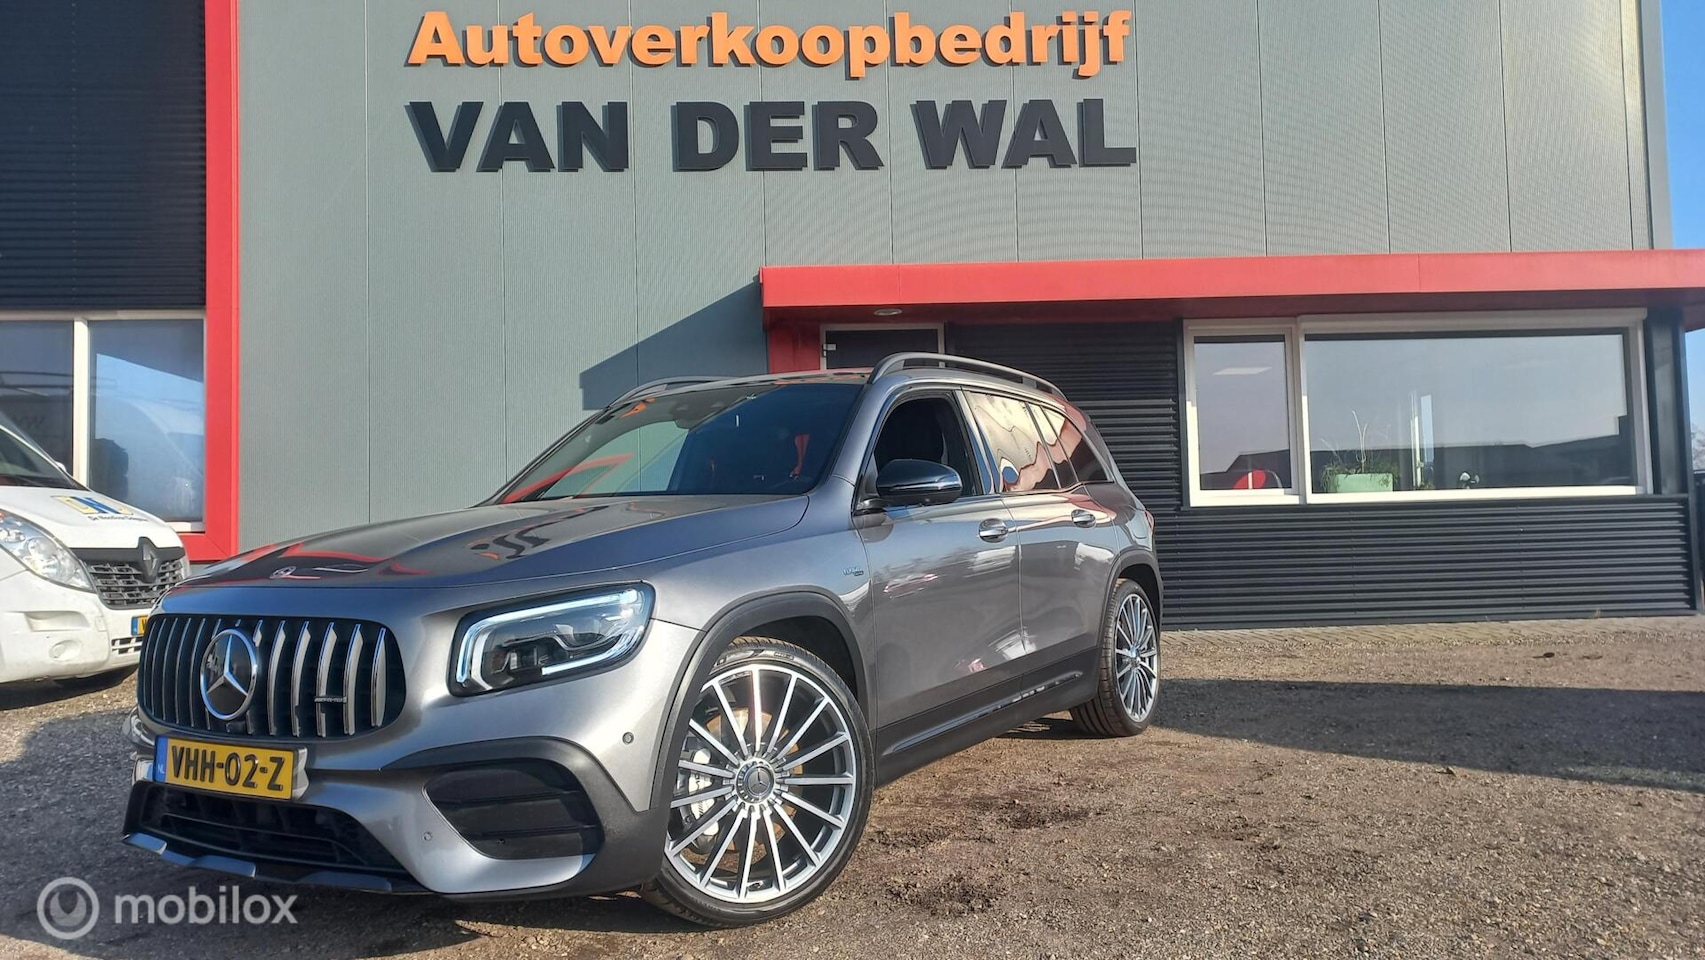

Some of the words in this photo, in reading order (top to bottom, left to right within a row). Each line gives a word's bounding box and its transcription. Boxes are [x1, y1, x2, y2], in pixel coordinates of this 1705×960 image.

[406, 10, 1132, 79] Autoverkoopbedrijf
[407, 101, 630, 171] VAN
[674, 100, 884, 171] DER
[912, 98, 1137, 169] WAL
[171, 745, 285, 791] VHH-02-Z
